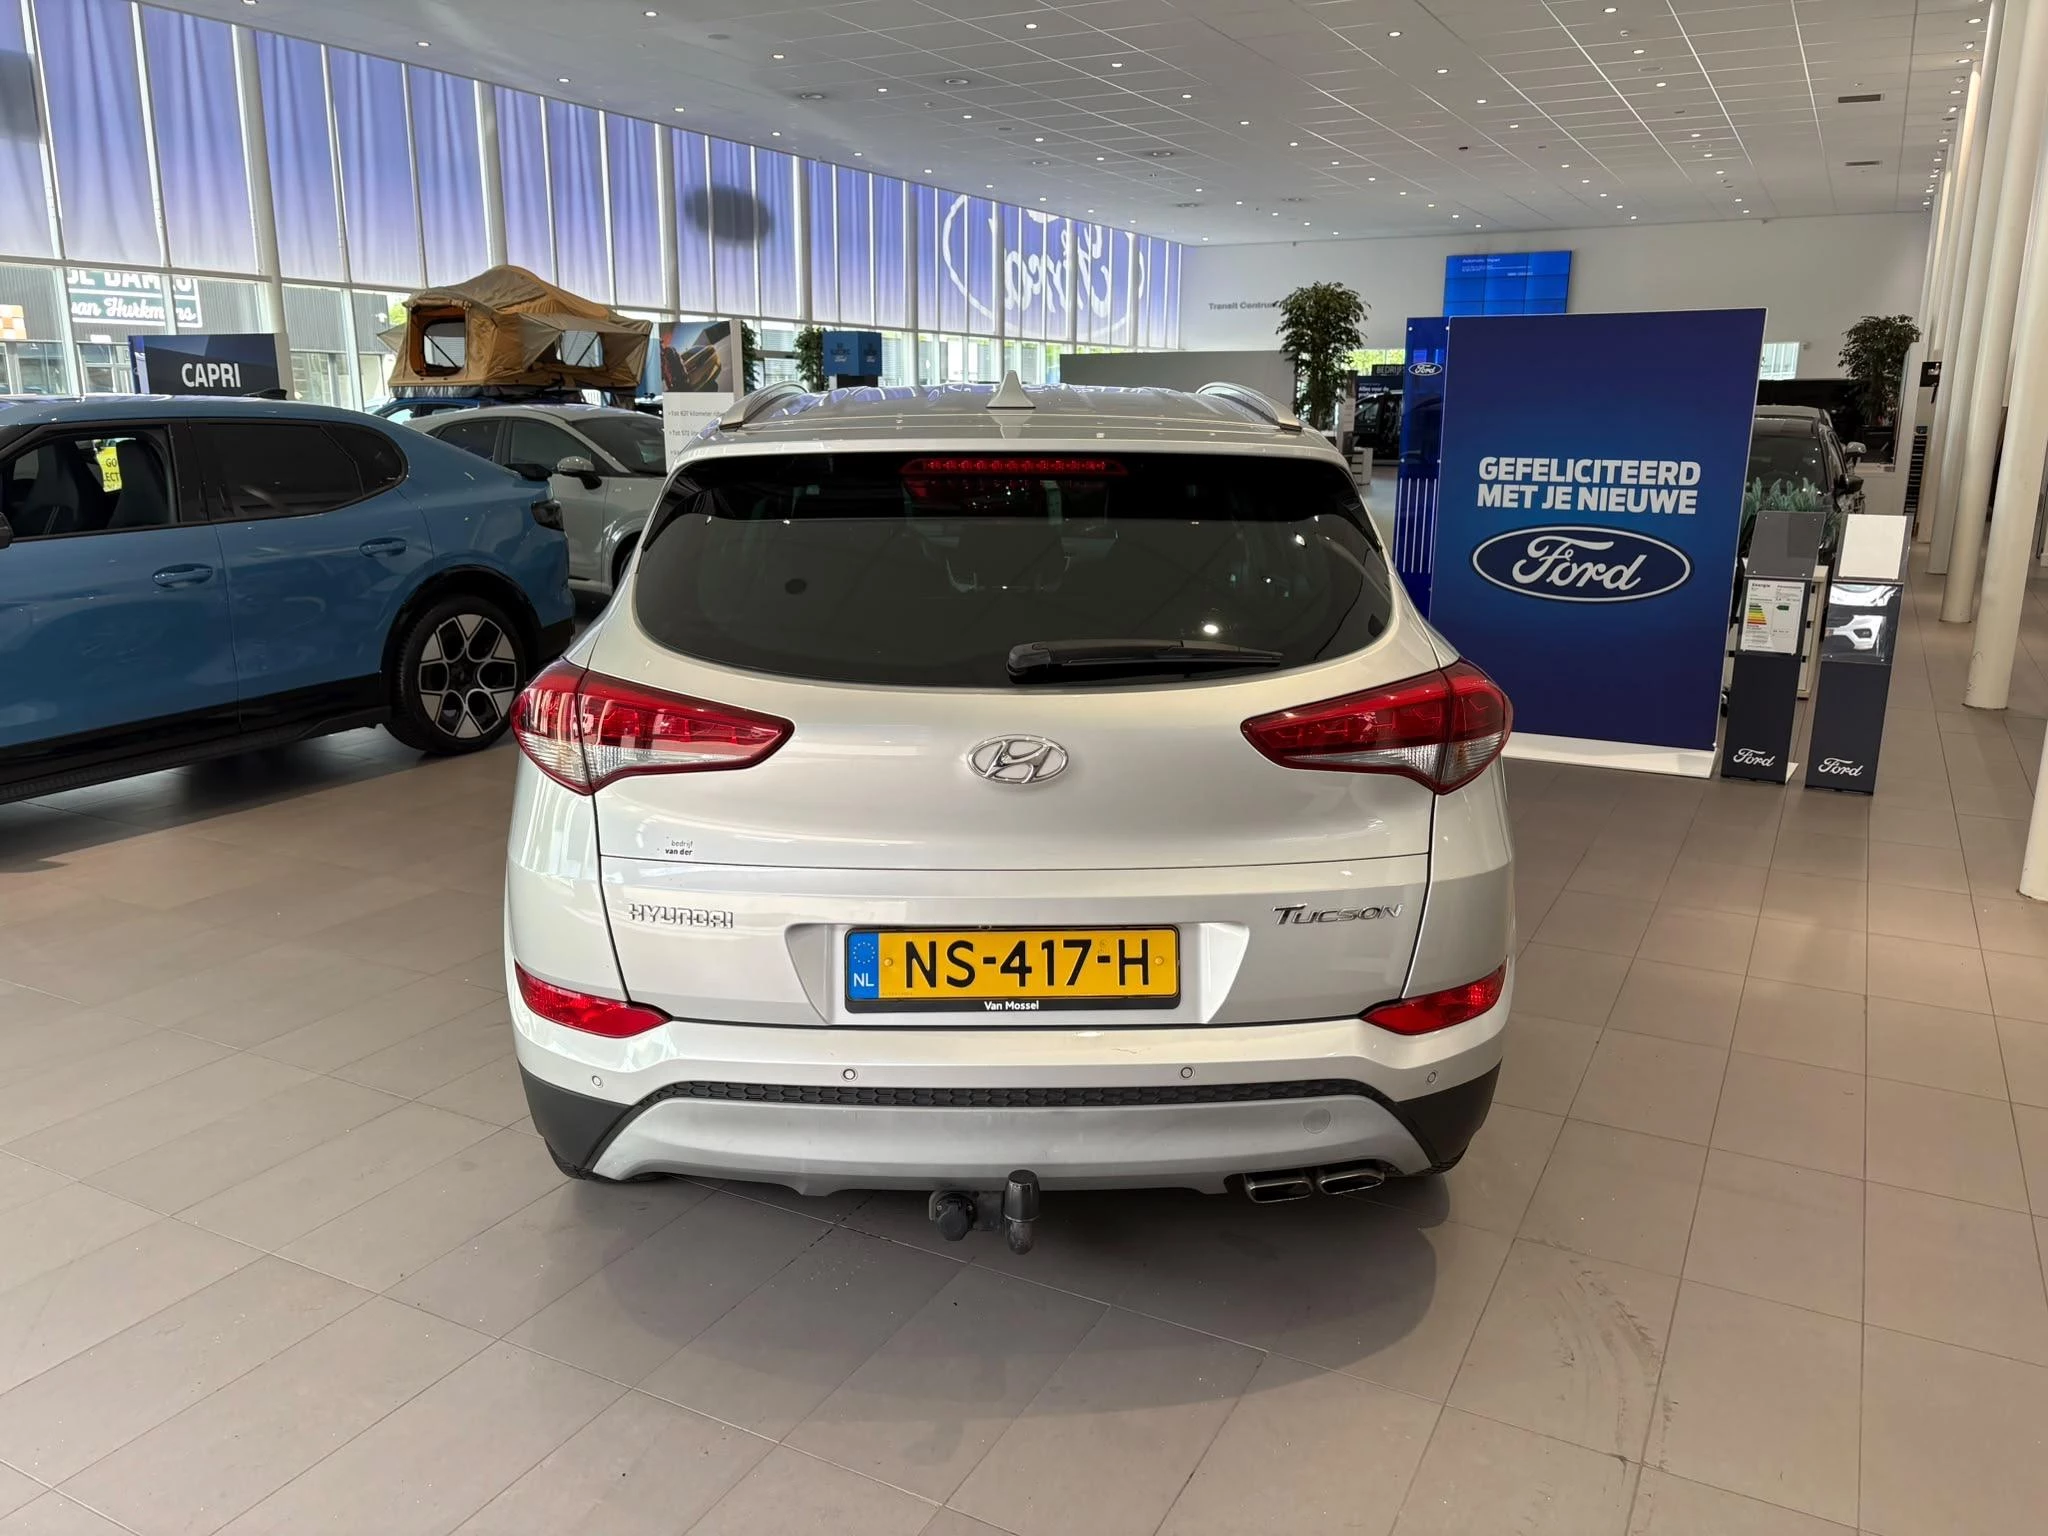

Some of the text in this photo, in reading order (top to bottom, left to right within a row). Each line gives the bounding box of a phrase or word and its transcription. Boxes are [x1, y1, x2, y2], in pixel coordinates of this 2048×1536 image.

[104, 297, 197, 321] Hurkmns
[1207, 301, 1275, 310] Transit Centru
[181, 362, 241, 388] CAPRI
[105, 458, 118, 468] GO
[1478, 456, 1701, 486] GEFELICITEERD
[1477, 483, 1698, 515] MET JE NIEUWE
[1511, 535, 1648, 591] Ford
[1732, 748, 1776, 767] Ford
[1817, 757, 1864, 777] Ford
[671, 840, 693, 849] bedrijf
[680, 848, 693, 856] der
[629, 903, 734, 929] HYUNDAI
[853, 938, 1150, 989] NL NS-417-H
[984, 1000, 1040, 1011] Van Mossel
